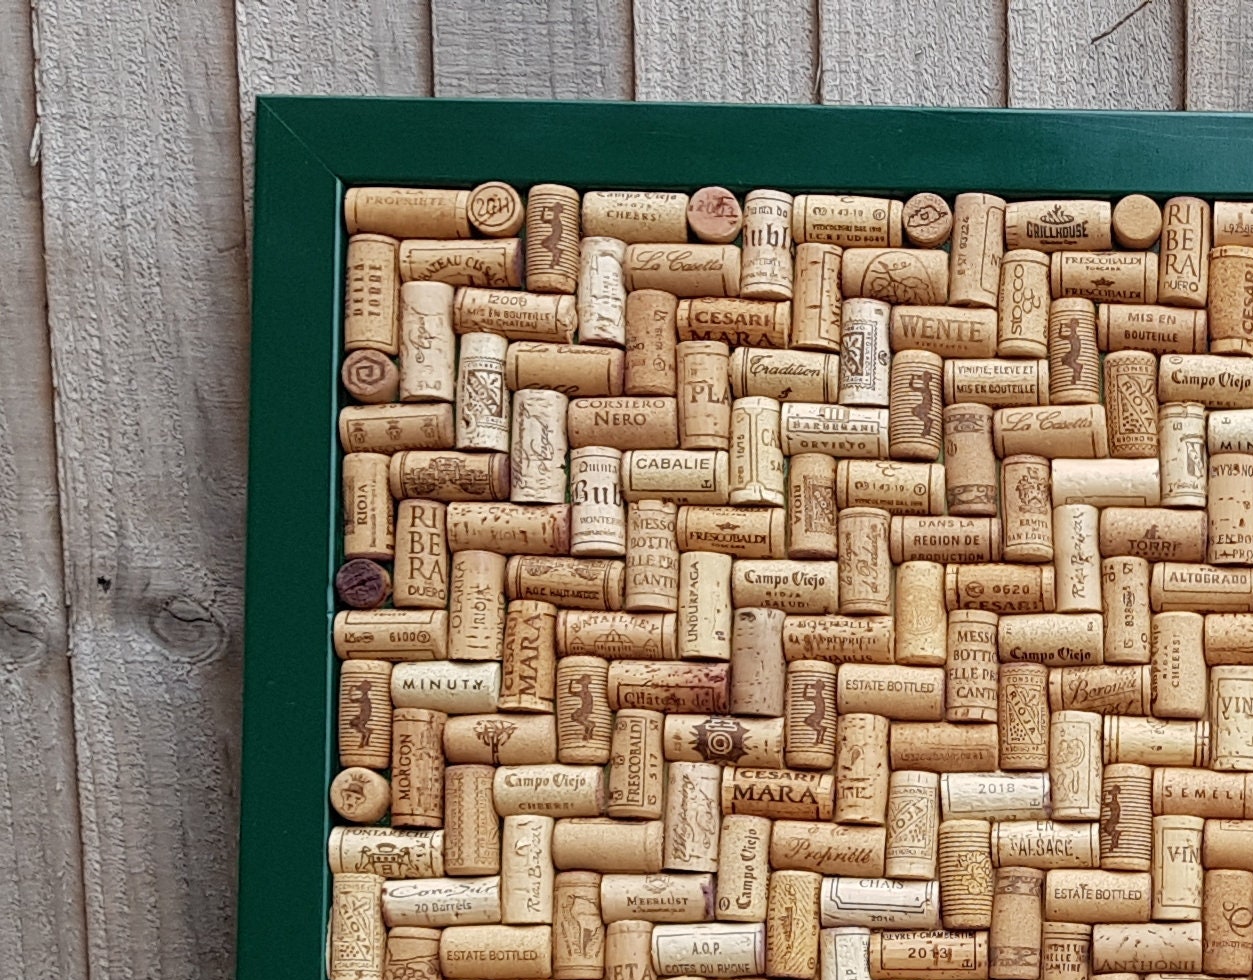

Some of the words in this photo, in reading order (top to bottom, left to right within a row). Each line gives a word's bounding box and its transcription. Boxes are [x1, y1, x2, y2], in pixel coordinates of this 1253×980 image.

[1026, 220, 1090, 240] GRILLHOUSE
[694, 312, 772, 326] CESARI
[900, 314, 985, 344] WENTE
[1124, 331, 1179, 343] BOUTEILLE
[1171, 368, 1216, 387] Campo
[1220, 369, 1252, 390] Viejo
[636, 457, 711, 471] CABALIE
[357, 483, 368, 525] RIOJA
[689, 531, 767, 546] FRESCOBALDI
[913, 535, 961, 547] REGION
[964, 535, 981, 546] DE
[744, 569, 790, 586] Campo
[793, 570, 825, 587] Viejo
[518, 610, 542, 696] MARA
[1009, 647, 1055, 663] Campo
[1059, 648, 1092, 663] Viejo
[402, 678, 484, 691] MINUTY
[845, 679, 885, 692] ESTATE
[888, 681, 935, 695] BOTTLED
[399, 733, 412, 801] MORGON
[505, 773, 550, 790] Campo
[553, 773, 587, 791] Viejo
[978, 782, 1016, 795] 2018
[733, 784, 818, 803] MARA
[738, 827, 757, 861] Viejo
[736, 863, 752, 910] Campo
[1054, 886, 1092, 901] ESTATE
[1095, 886, 1142, 901] BOTTLED
[626, 895, 690, 907] MEERLUST
[446, 950, 484, 962] ESTATE
[487, 949, 538, 962] BOTTLED
[664, 964, 698, 976] COTES
[700, 964, 714, 975] DU
[717, 963, 751, 975] RHONE
